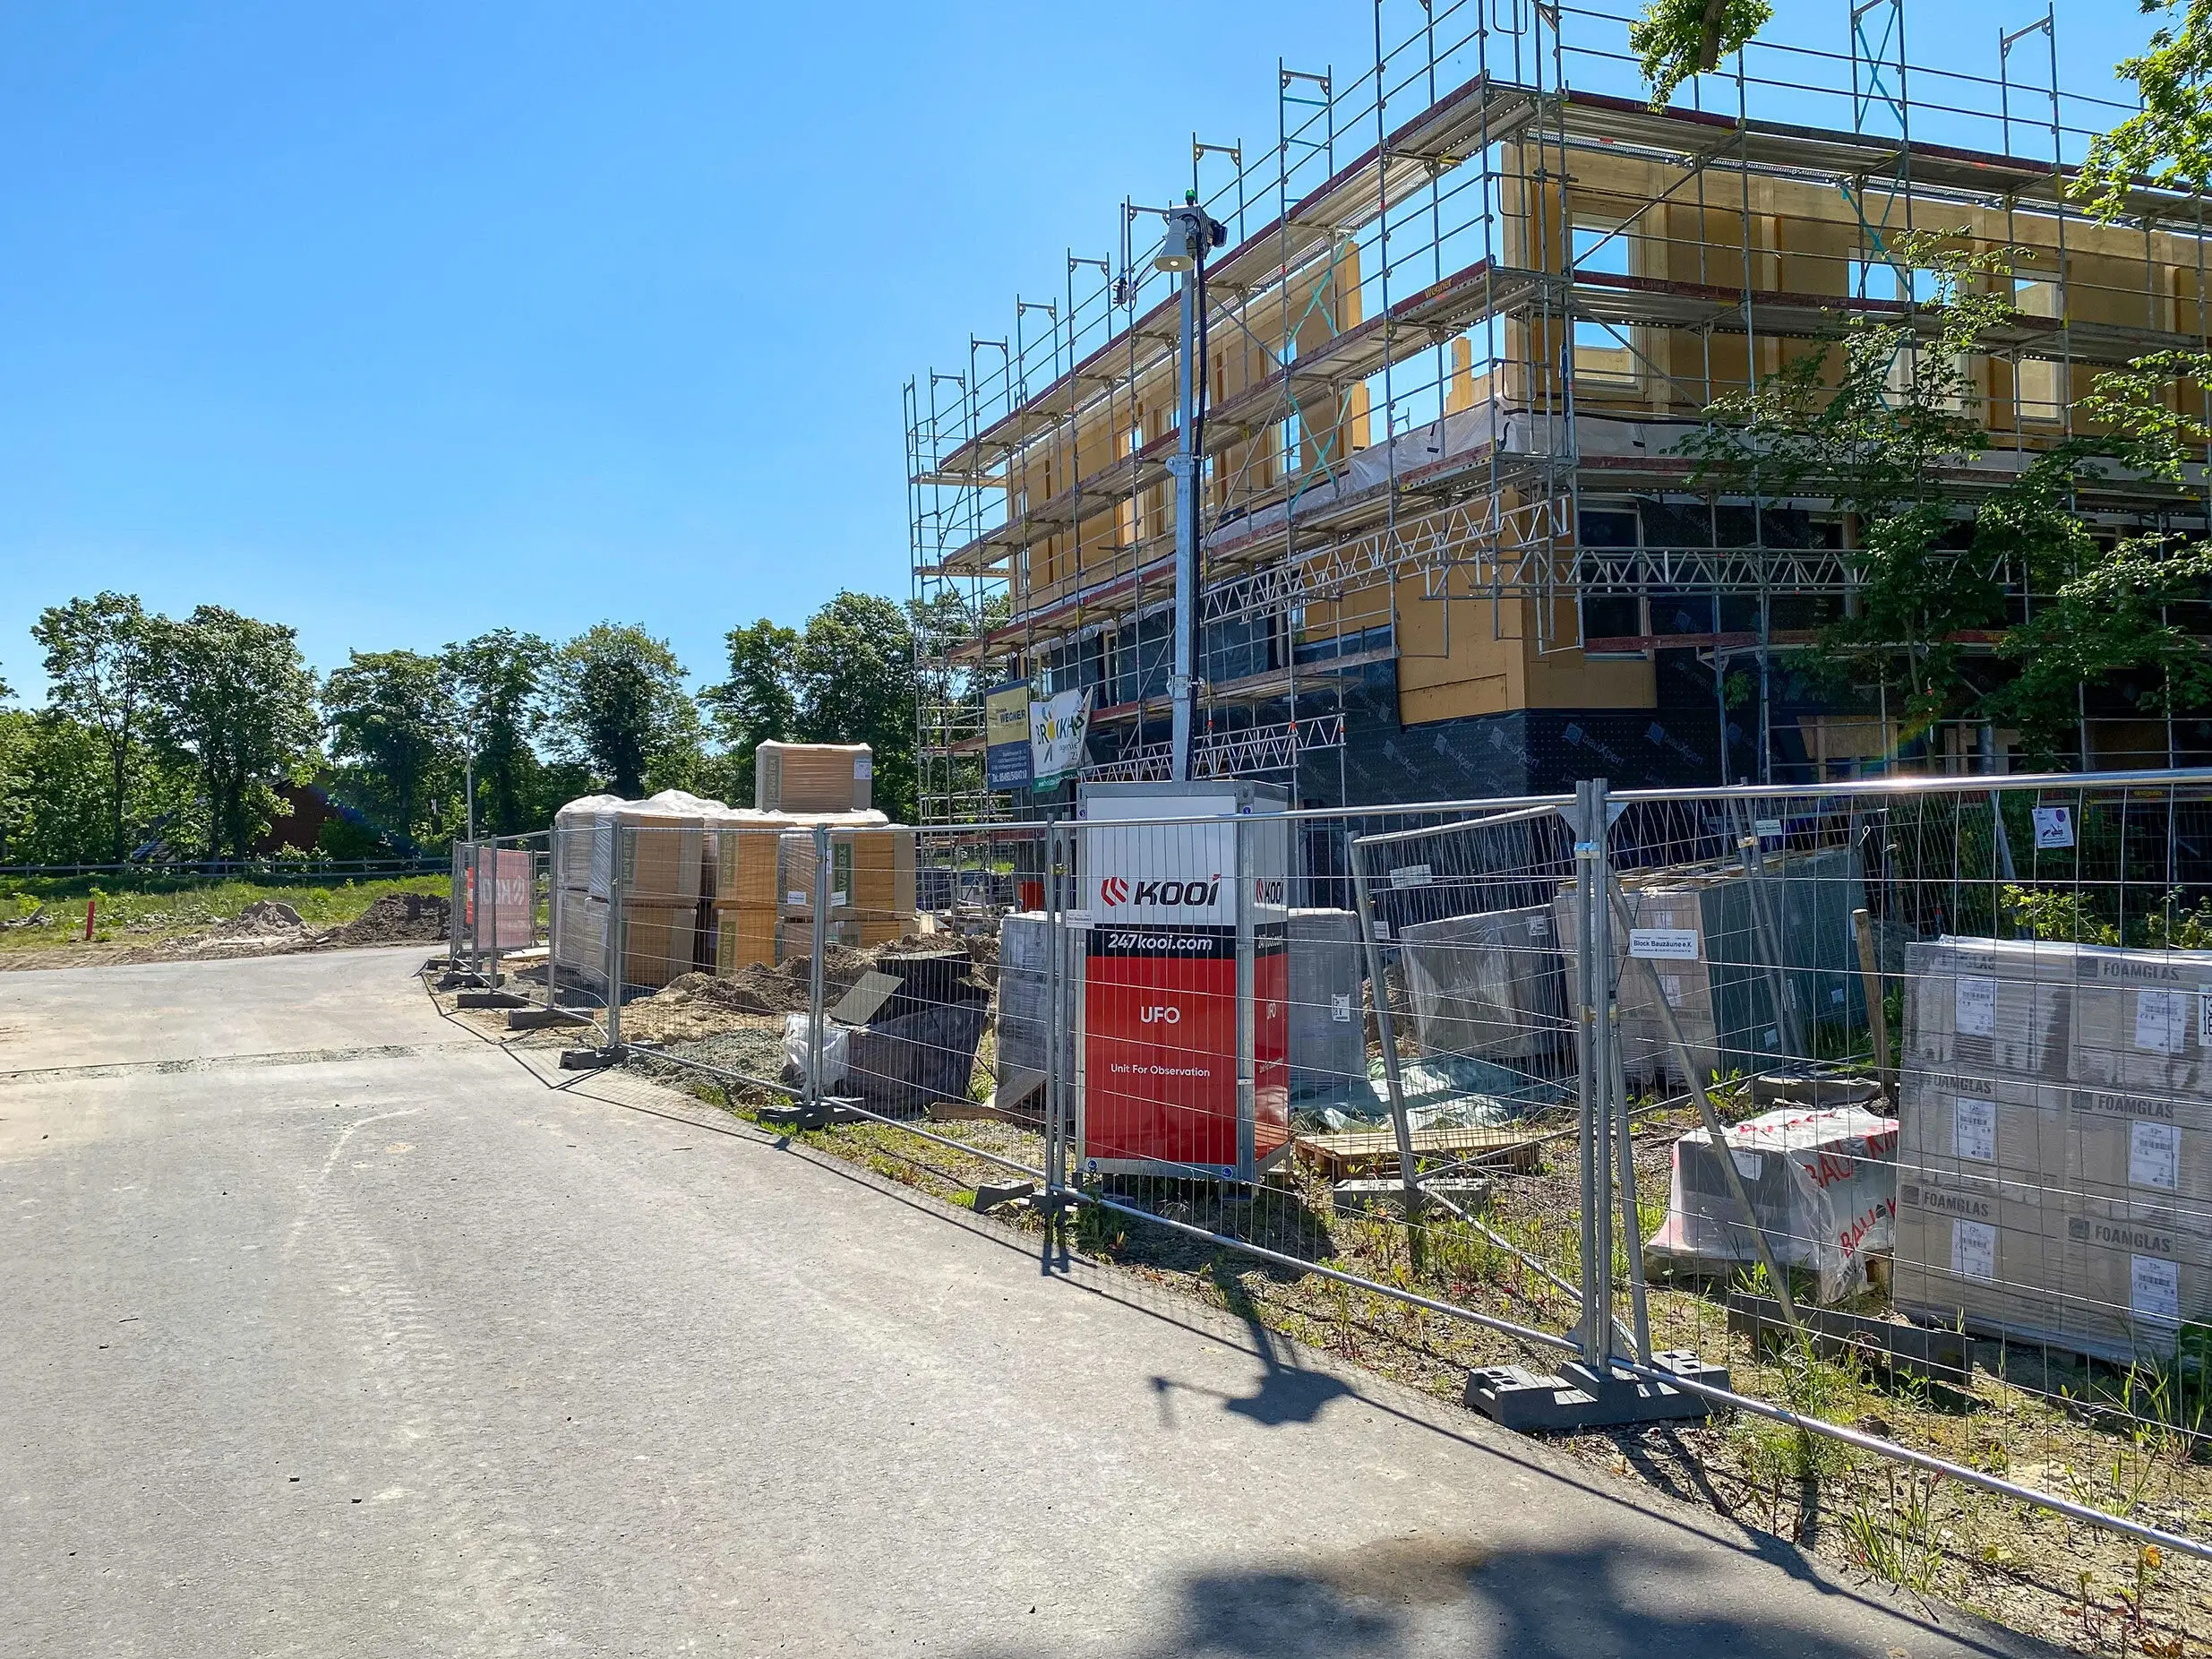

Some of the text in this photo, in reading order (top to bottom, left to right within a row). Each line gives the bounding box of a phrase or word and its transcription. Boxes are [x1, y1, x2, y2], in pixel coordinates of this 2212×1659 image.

[838, 843, 848, 893] avatex
[1108, 933, 1213, 950] 247kooi.com
[2104, 961, 2180, 981] FOAMGLAS
[1140, 1006, 1181, 1024] UFO
[1110, 1063, 1211, 1077] Unit For Observation
[2098, 1095, 2174, 1119] FOAMGLAS
[1924, 1191, 1989, 1217] FOAMGLAS
[2096, 1225, 2172, 1253] FOAMGLAS
